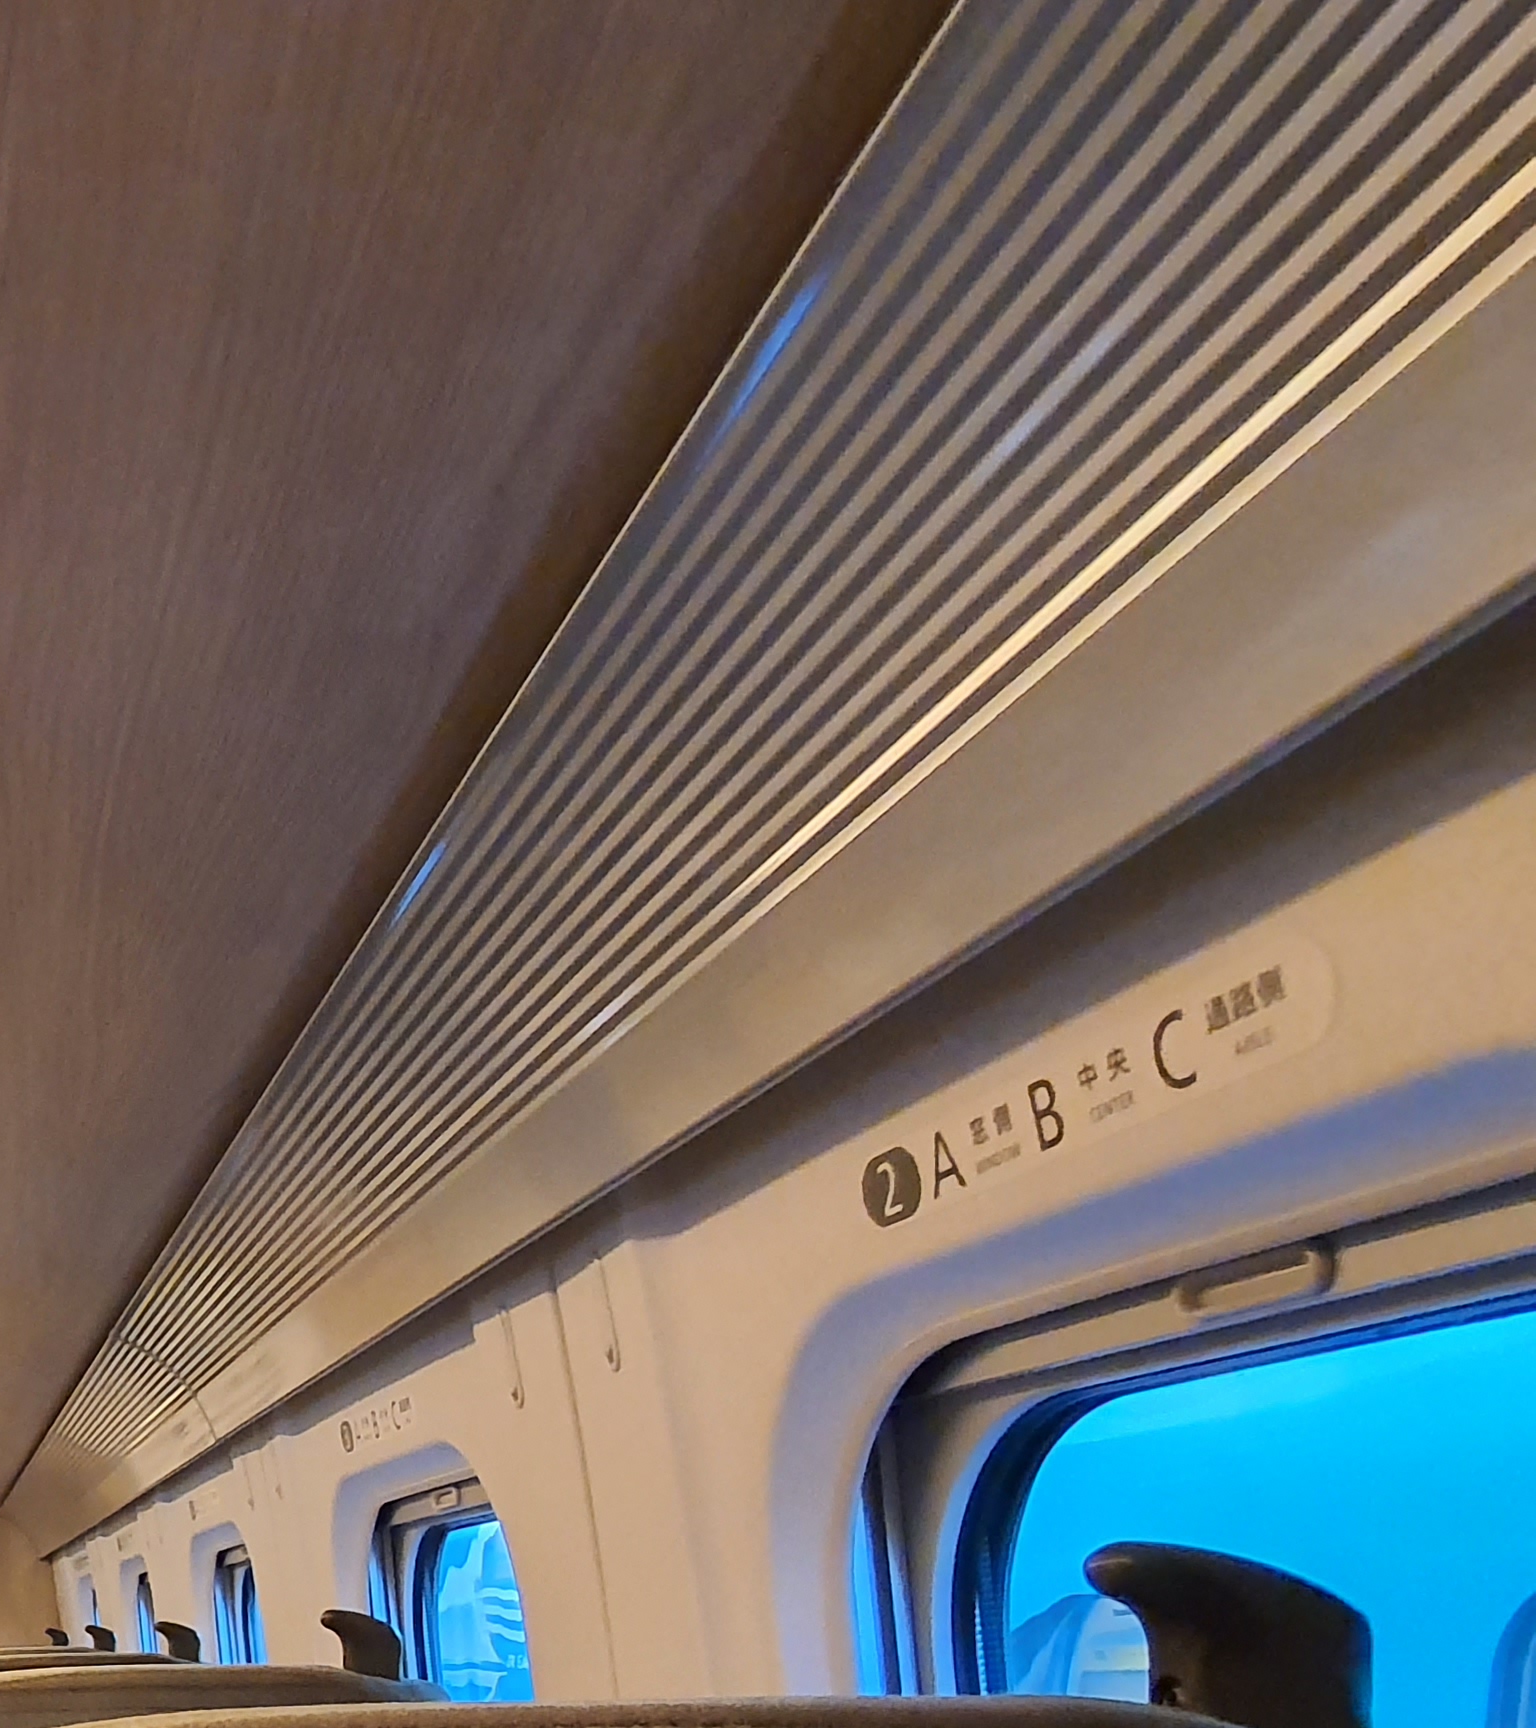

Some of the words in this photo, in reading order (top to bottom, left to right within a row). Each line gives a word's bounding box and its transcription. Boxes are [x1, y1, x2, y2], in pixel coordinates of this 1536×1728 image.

[875, 1161, 904, 1217] 2
[933, 1131, 967, 1199] A
[1027, 1078, 1064, 1152] B
[1078, 1047, 1131, 1091] 中央
[1153, 1009, 1197, 1089] C
